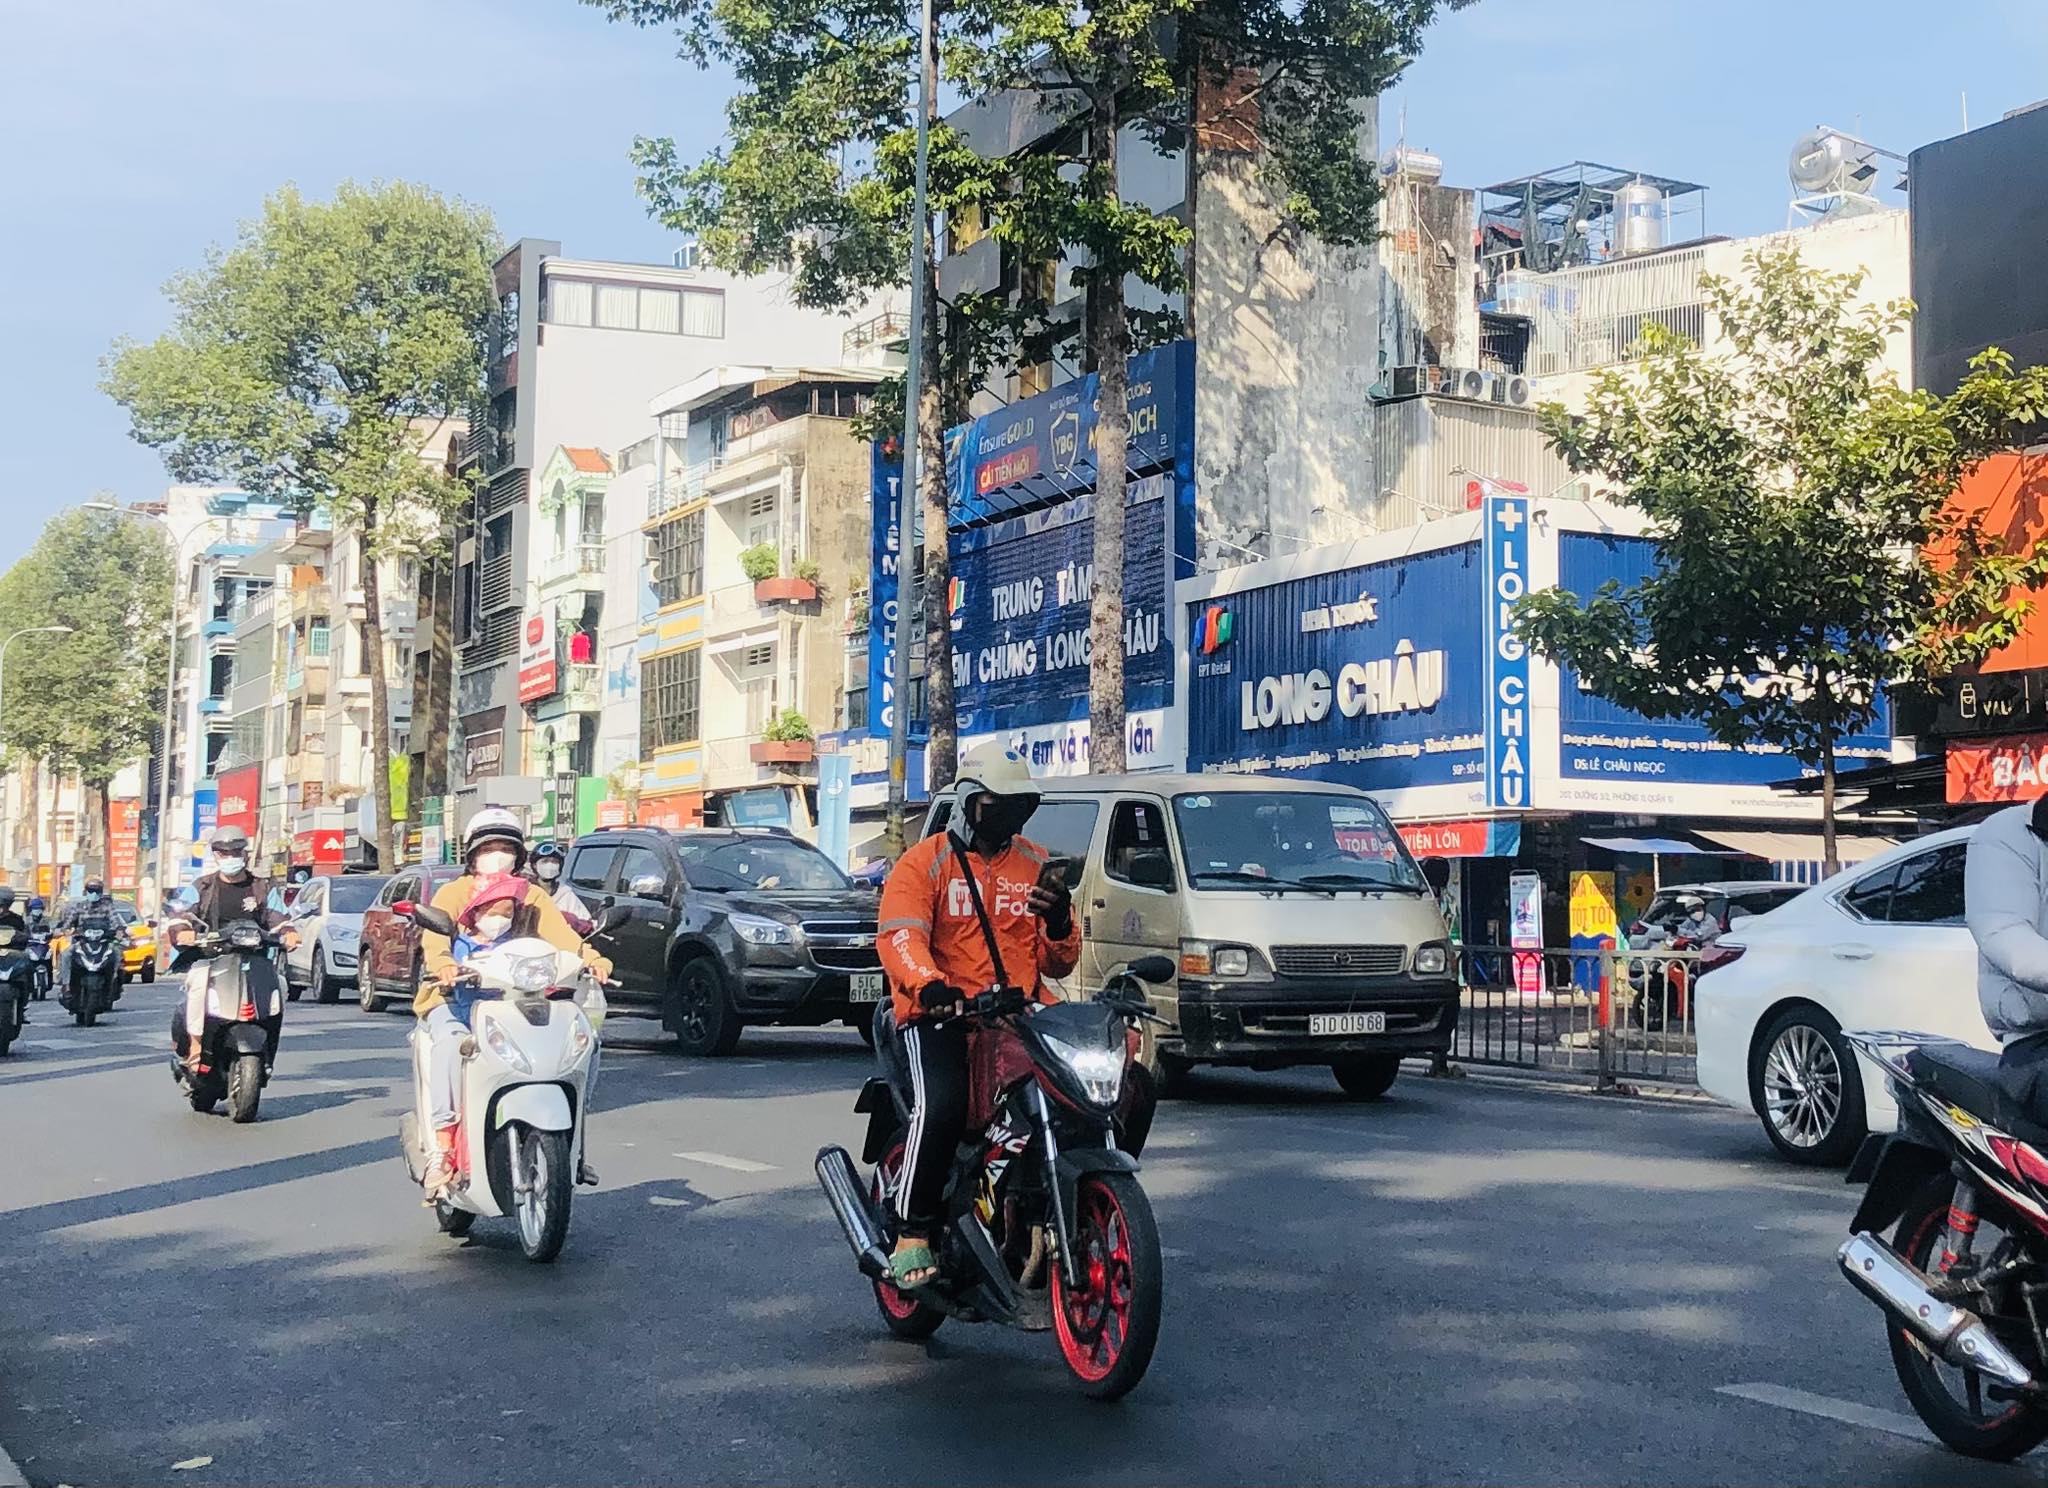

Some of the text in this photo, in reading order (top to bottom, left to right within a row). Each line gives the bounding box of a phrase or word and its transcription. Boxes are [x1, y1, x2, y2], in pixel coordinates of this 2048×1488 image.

[991, 560, 1094, 622] TRUNG TÂM
[978, 630, 1038, 683] CHỦNG
[1045, 627, 1092, 672] LONG
[1122, 607, 1160, 657] HÂU
[1241, 638, 1446, 731] LONG CHÂU
[1498, 675, 1526, 806] CHÂU
[1633, 761, 1667, 776] NGỌC
[1435, 829, 1460, 849] LỚN
[857, 975, 876, 989] 51C
[1312, 1016, 1337, 1033] 51D
